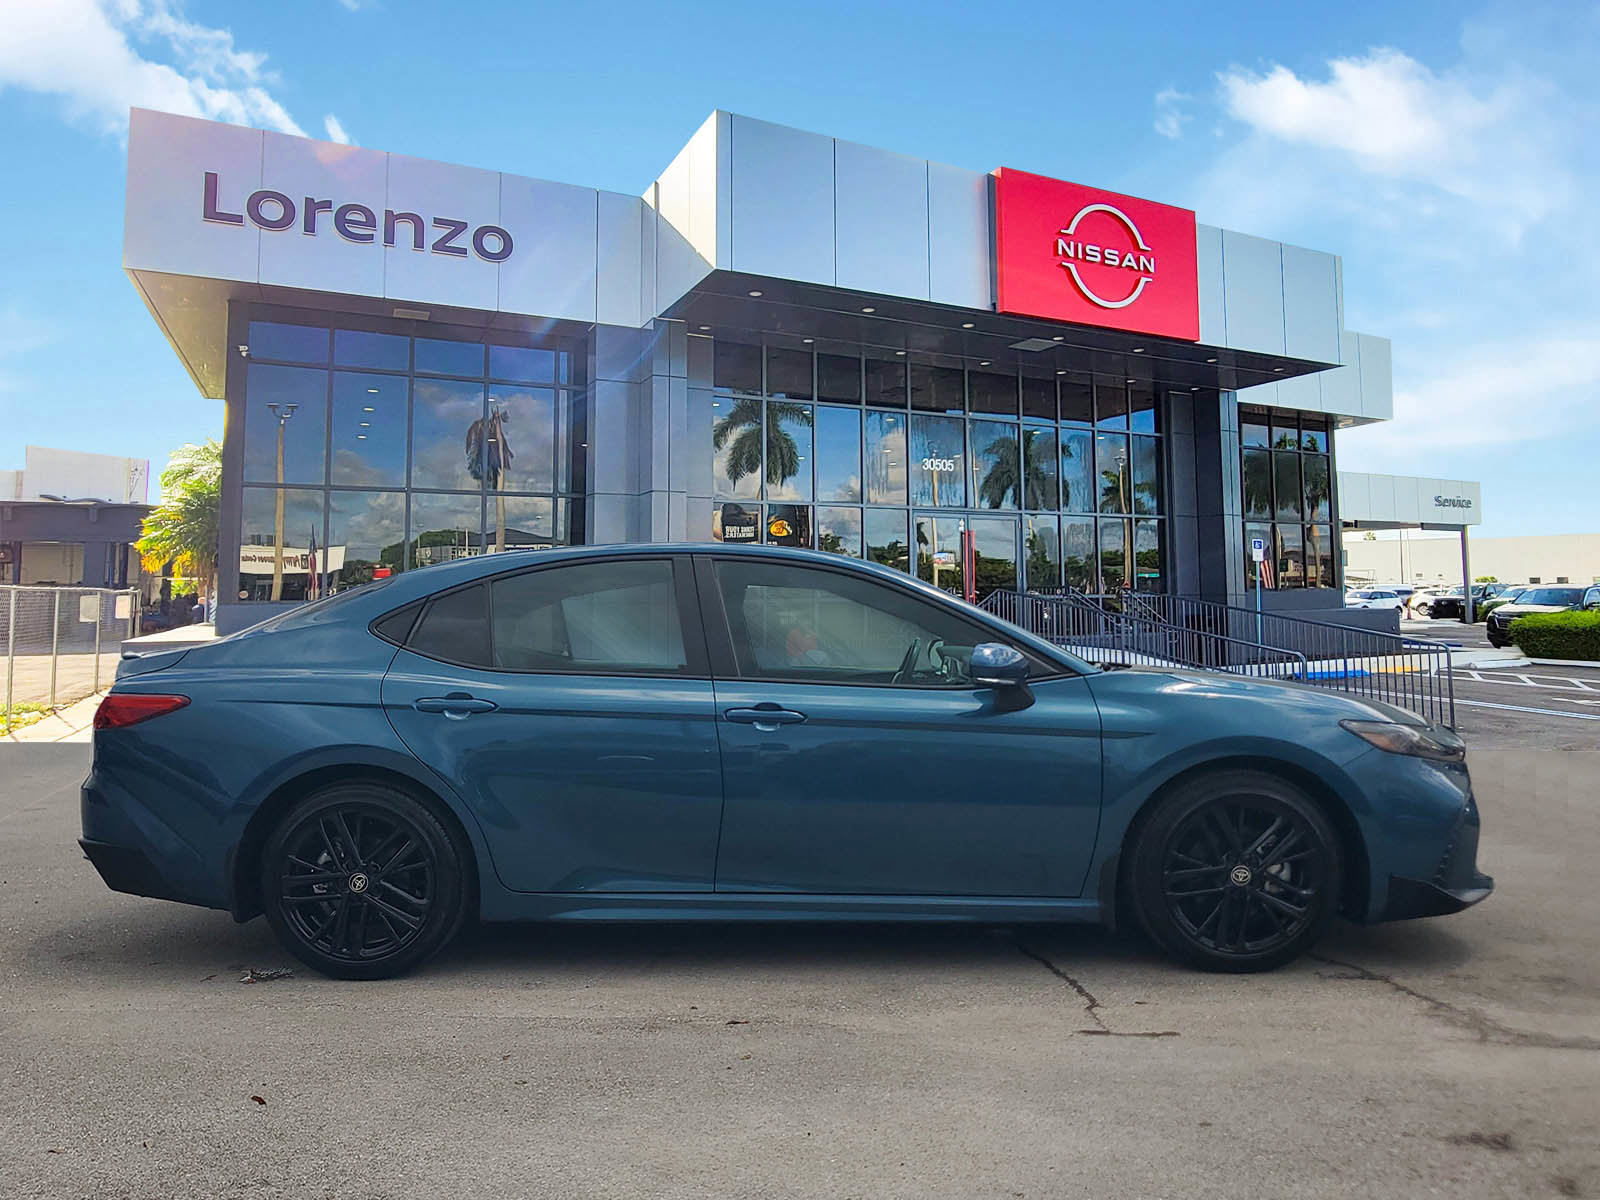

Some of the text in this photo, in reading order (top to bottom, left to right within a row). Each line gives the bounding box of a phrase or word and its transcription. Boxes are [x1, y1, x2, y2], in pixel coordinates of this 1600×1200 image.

[202, 171, 514, 262] Lorenzo
[1057, 238, 1155, 273] NISSAN
[922, 458, 954, 472] 30505
[1434, 495, 1472, 509] Service
